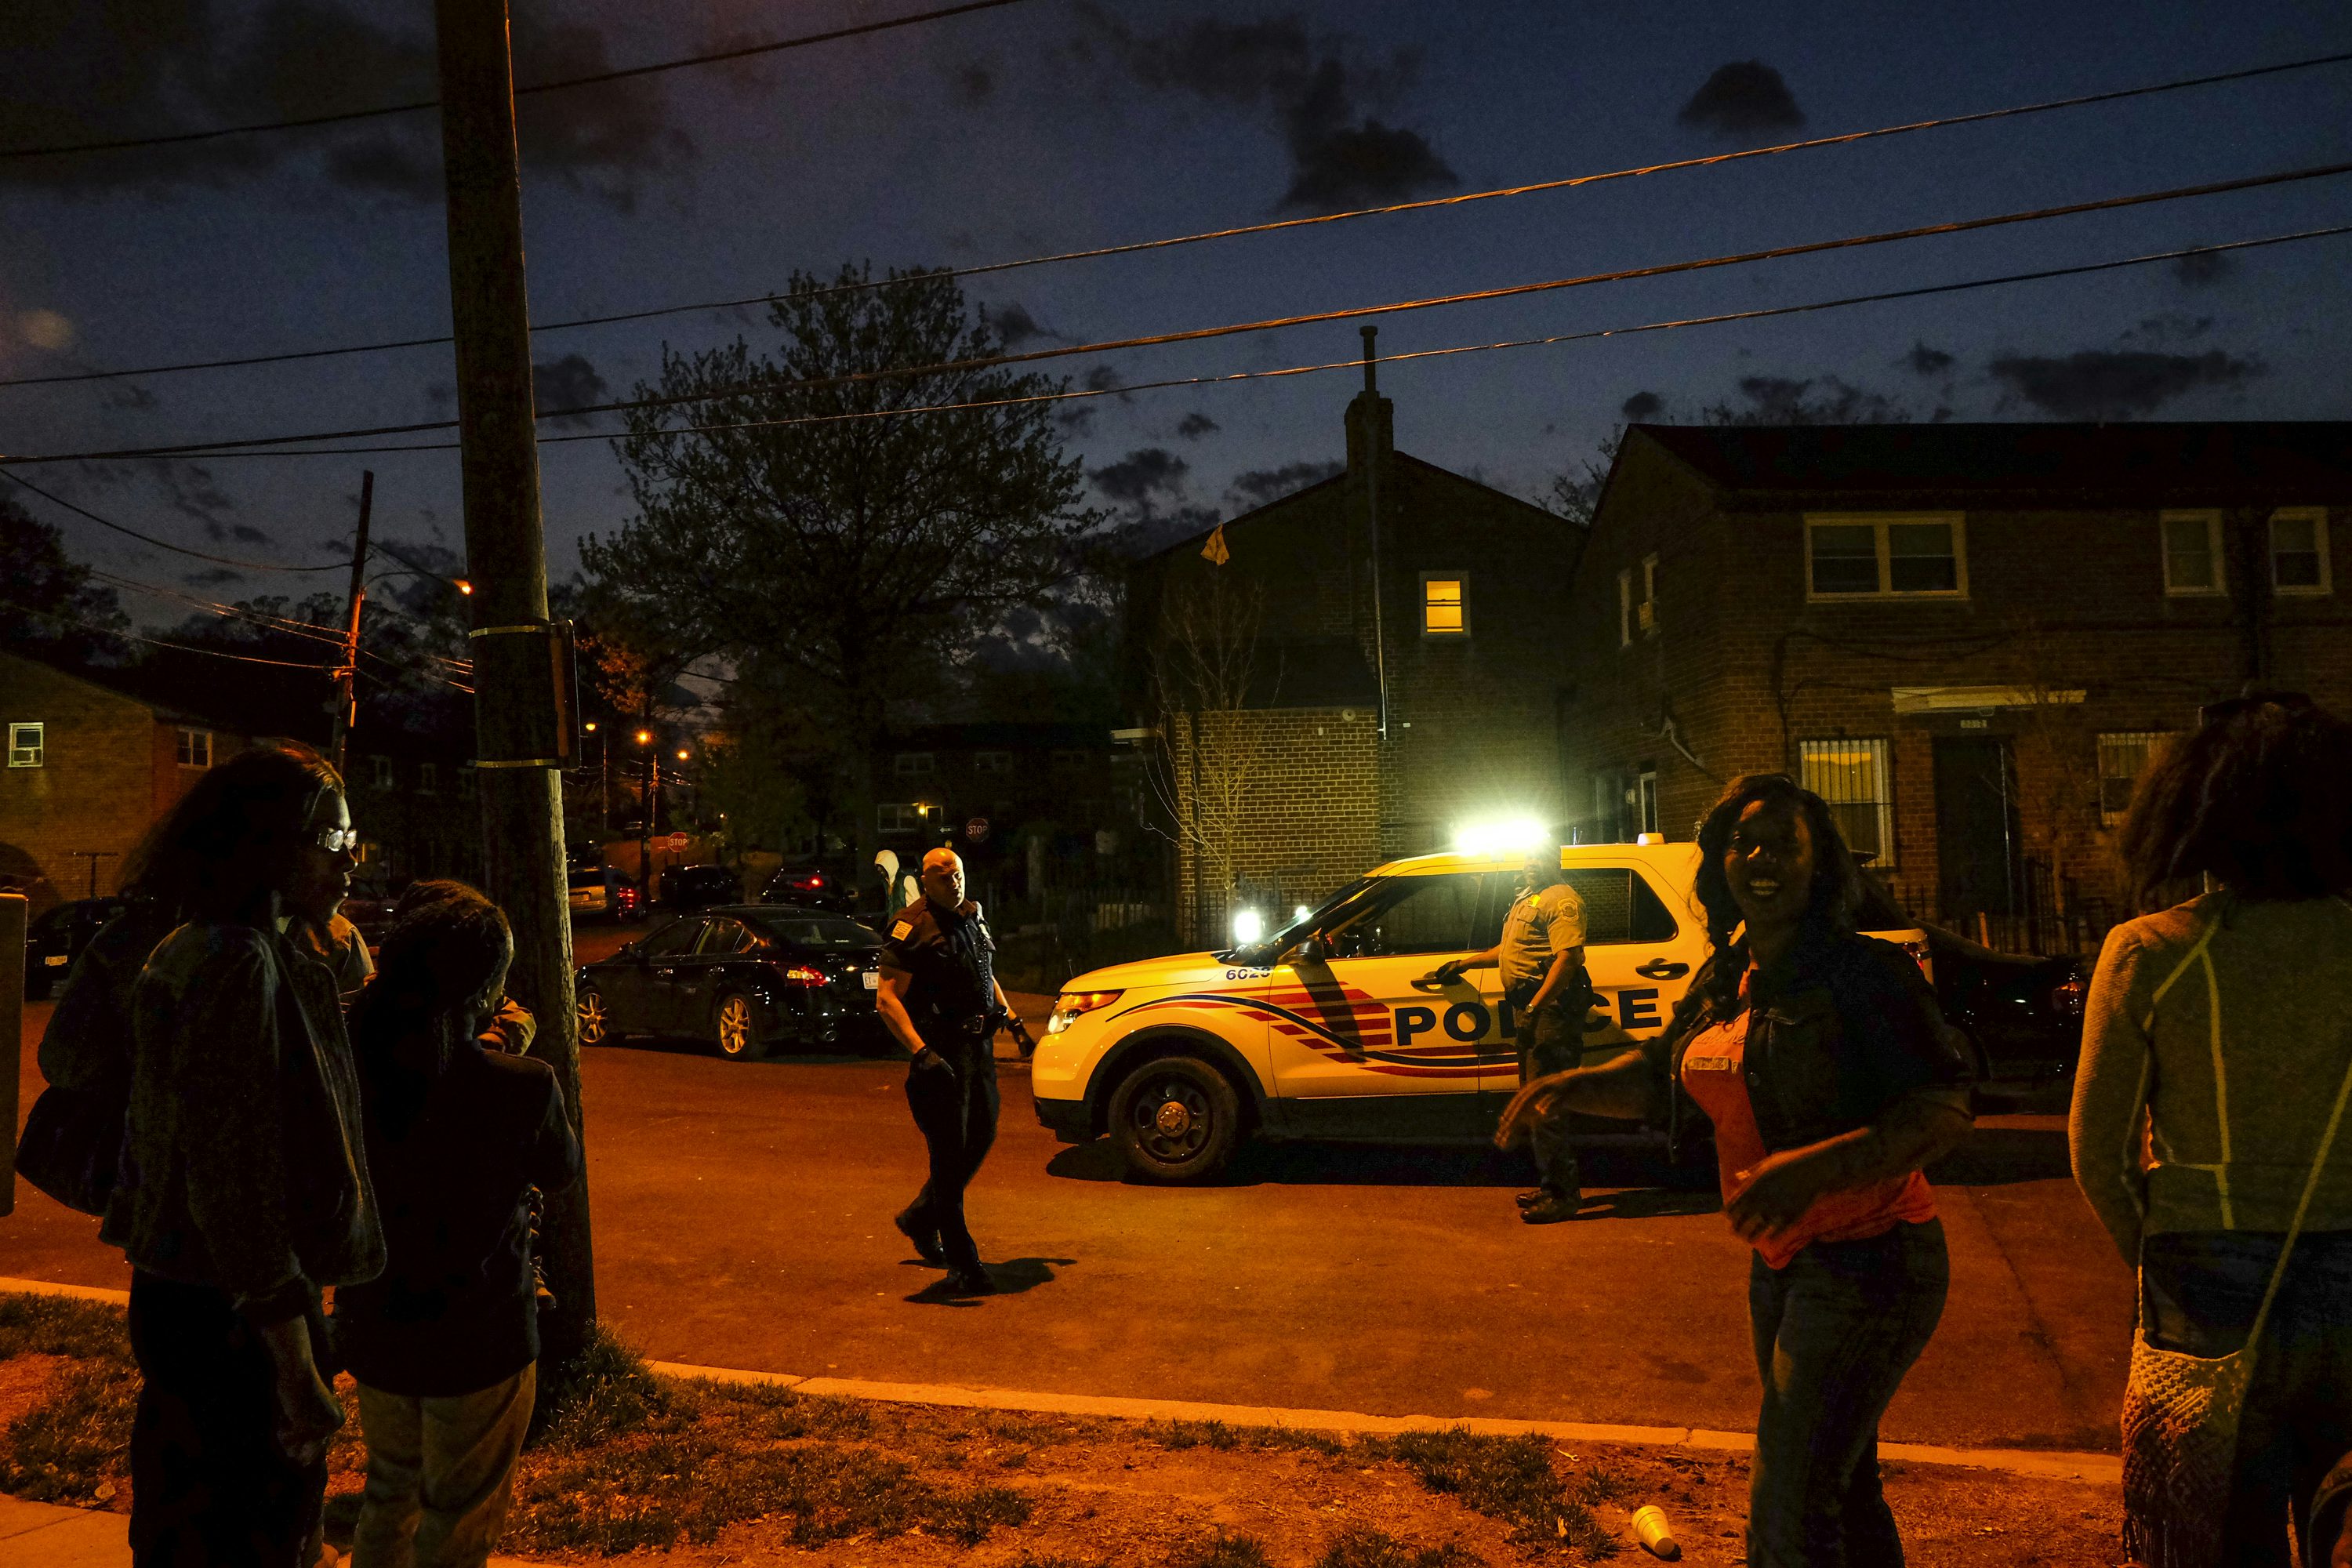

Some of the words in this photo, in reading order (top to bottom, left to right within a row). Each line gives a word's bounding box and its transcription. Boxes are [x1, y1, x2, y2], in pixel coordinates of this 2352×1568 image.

[967, 826, 988, 835] STOP
[670, 838, 688, 847] STOP
[1395, 989, 1662, 1046] POLCE
